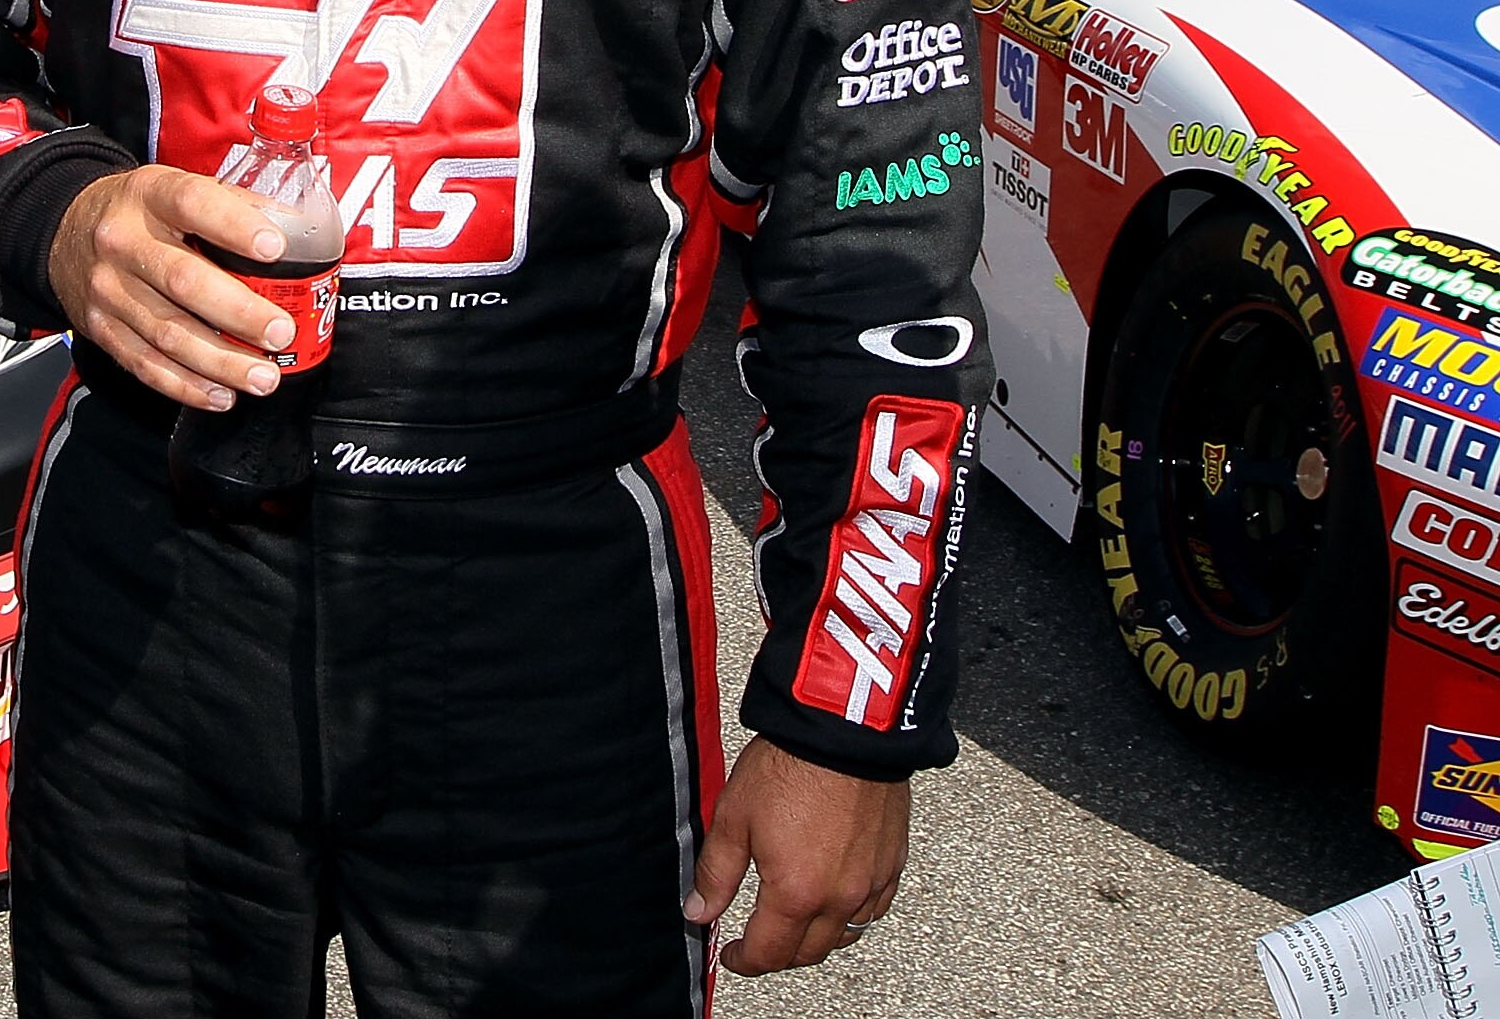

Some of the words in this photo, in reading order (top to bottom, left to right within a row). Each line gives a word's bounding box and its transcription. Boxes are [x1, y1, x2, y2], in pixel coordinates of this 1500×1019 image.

[841, 19, 963, 74] Office
[1042, 36, 1069, 60] WEAR
[1070, 50, 1087, 67] HP
[1088, 60, 1129, 91] CARBS
[1074, 11, 1158, 95] Holley
[999, 38, 1034, 122] USG
[1064, 82, 1126, 178] 3M
[836, 153, 950, 211] IAMS
[993, 162, 1049, 217] TISSOT
[1168, 122, 1357, 256] GOODYEAR
[450, 291, 508, 309] Inc.
[1240, 222, 1343, 372] EAGLE
[1372, 358, 1486, 412] CHASSIS
[332, 441, 467, 474] Newman
[1207, 449, 1220, 485] AERO
[823, 411, 941, 726] HAAS
[1420, 811, 1471, 832] OFFICIAL
[1294, 950, 1314, 982] NSCS
[1302, 937, 1332, 993] Hampshire
[1329, 961, 1348, 998] LENOX
[1326, 993, 1339, 1015] New
